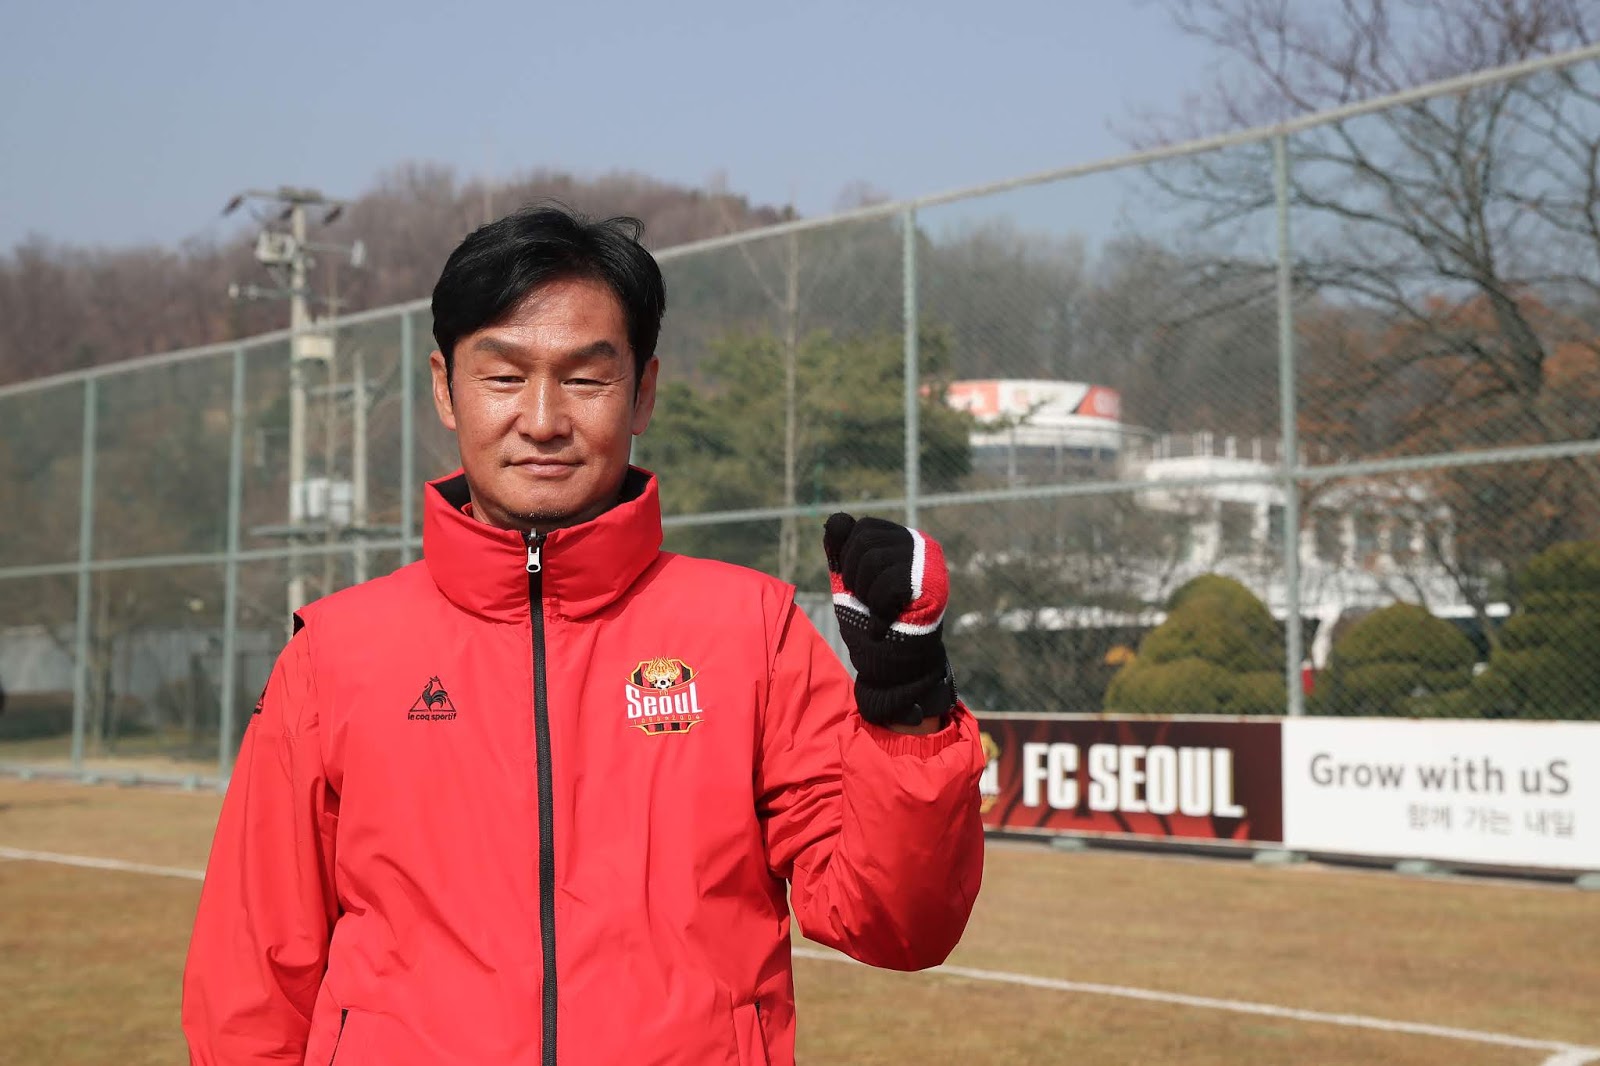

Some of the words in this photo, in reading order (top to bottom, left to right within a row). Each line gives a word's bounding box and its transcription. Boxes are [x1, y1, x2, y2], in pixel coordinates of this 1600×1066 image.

[407, 712, 415, 721] le
[415, 713, 430, 722] coq
[431, 712, 457, 722] sportif
[1022, 742, 1079, 809] FC
[1088, 743, 1246, 818] SEOUL
[1309, 753, 1404, 787] Grow
[1418, 755, 1504, 793] with
[1464, 805, 1512, 834] 가는
[1525, 808, 1575, 837] 내일
